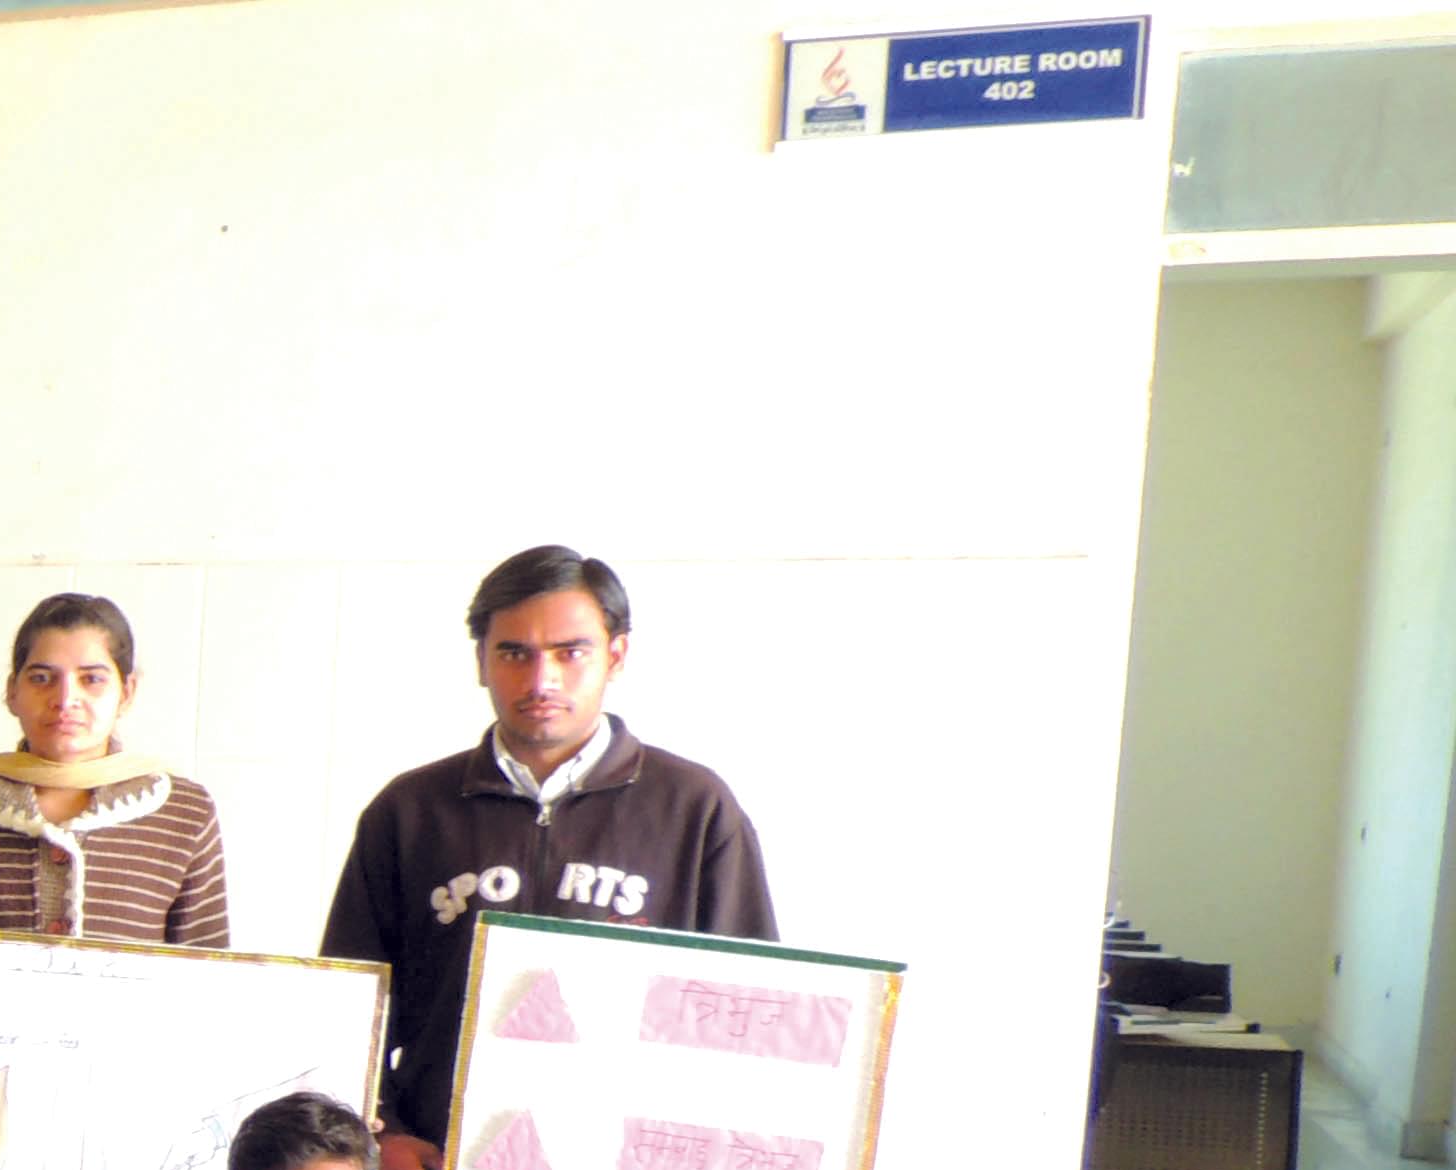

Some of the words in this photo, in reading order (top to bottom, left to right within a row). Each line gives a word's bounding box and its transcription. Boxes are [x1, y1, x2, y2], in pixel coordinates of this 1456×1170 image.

[904, 53, 1031, 81] LECTURE
[1038, 49, 1122, 72] ROOM
[983, 80, 1035, 101] 402
